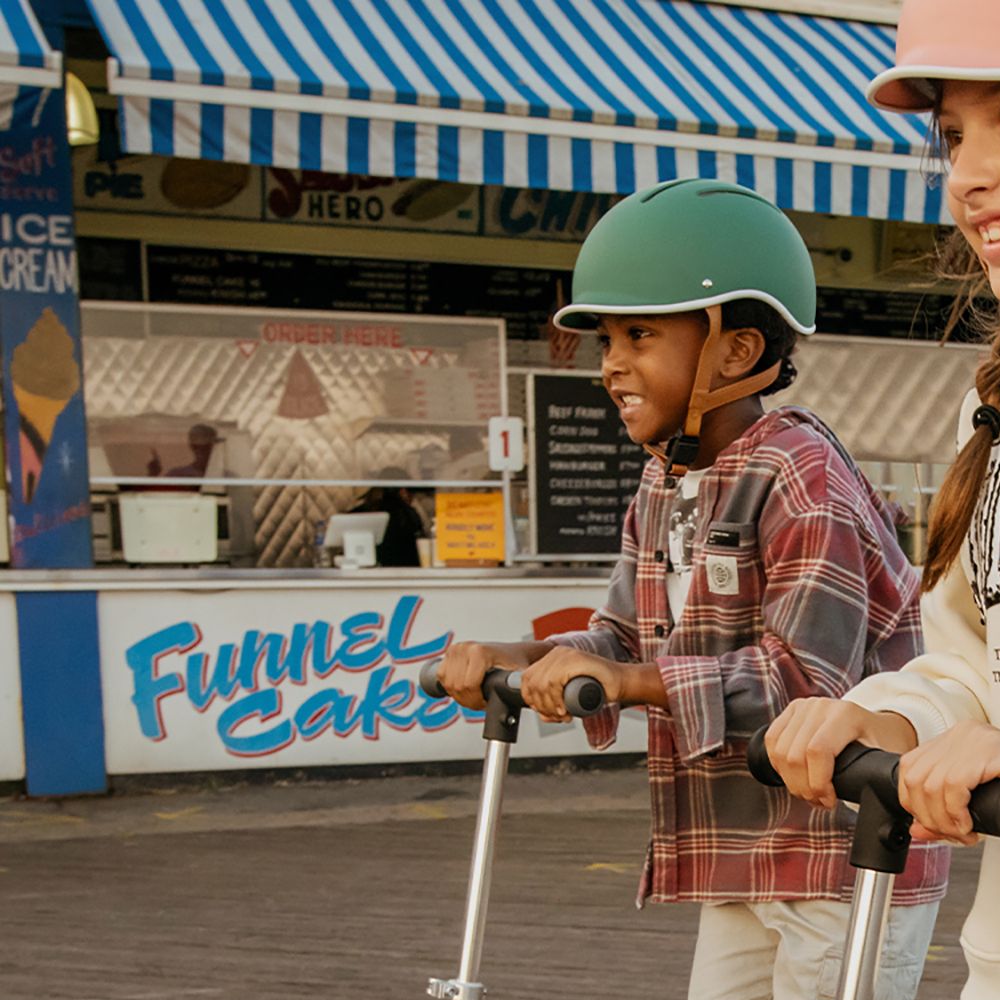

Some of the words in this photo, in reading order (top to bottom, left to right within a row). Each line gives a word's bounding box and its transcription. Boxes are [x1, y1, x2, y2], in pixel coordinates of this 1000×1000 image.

[85, 171, 143, 198] PIE
[308, 194, 384, 221] HERO
[1, 213, 73, 245] ICE
[0, 246, 79, 293] CREAM
[262, 321, 338, 345] ORDER
[343, 325, 405, 349] HERE
[500, 430, 510, 458] 1
[216, 665, 486, 760] Cake
